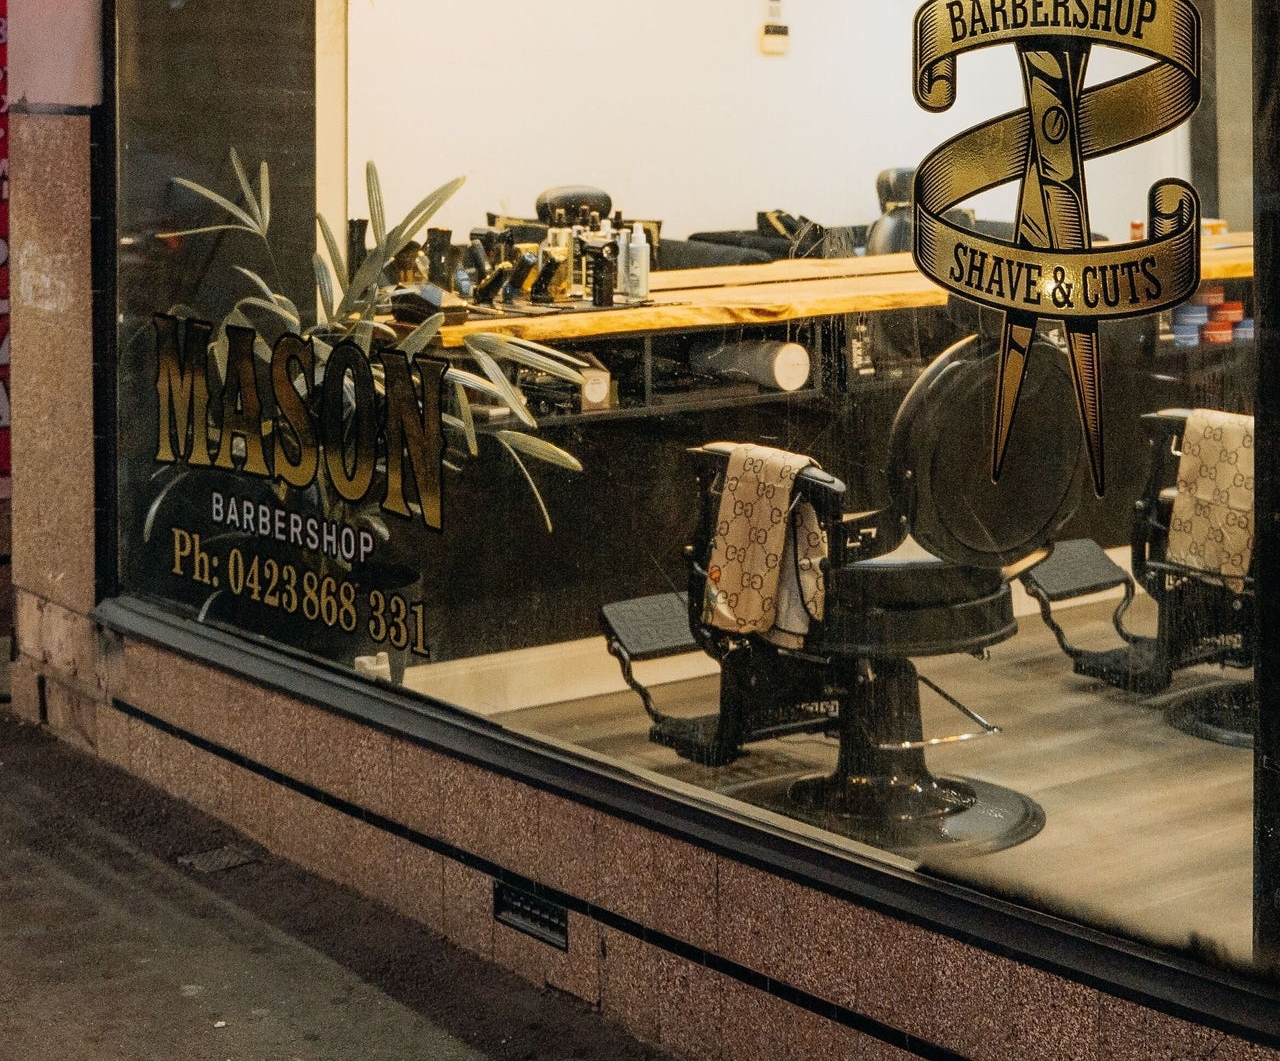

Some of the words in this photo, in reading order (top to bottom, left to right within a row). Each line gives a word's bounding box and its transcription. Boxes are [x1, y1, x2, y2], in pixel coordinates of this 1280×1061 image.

[949, 241, 1043, 306] SHAVE
[1051, 265, 1075, 310] &
[1081, 254, 1163, 309] CUTS
[152, 312, 451, 535] MASON
[211, 491, 375, 564] BARBERSHOP
[171, 526, 221, 588] Ph:
[368, 589, 431, 658] 331
